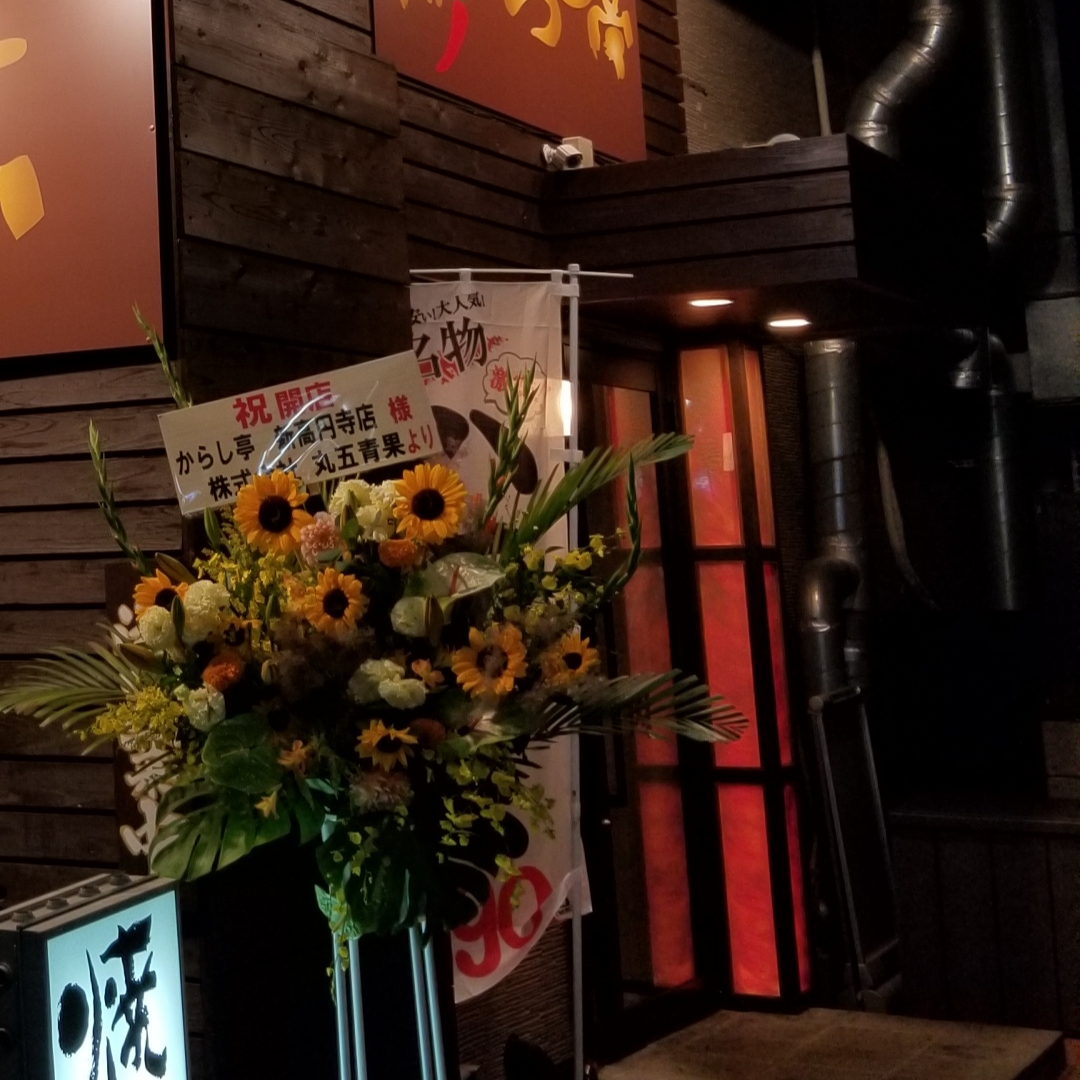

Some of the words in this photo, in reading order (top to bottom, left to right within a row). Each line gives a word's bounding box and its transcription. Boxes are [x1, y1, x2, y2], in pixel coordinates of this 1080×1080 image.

[176, 433, 256, 476] からし亭
[388, 394, 414, 424] 様
